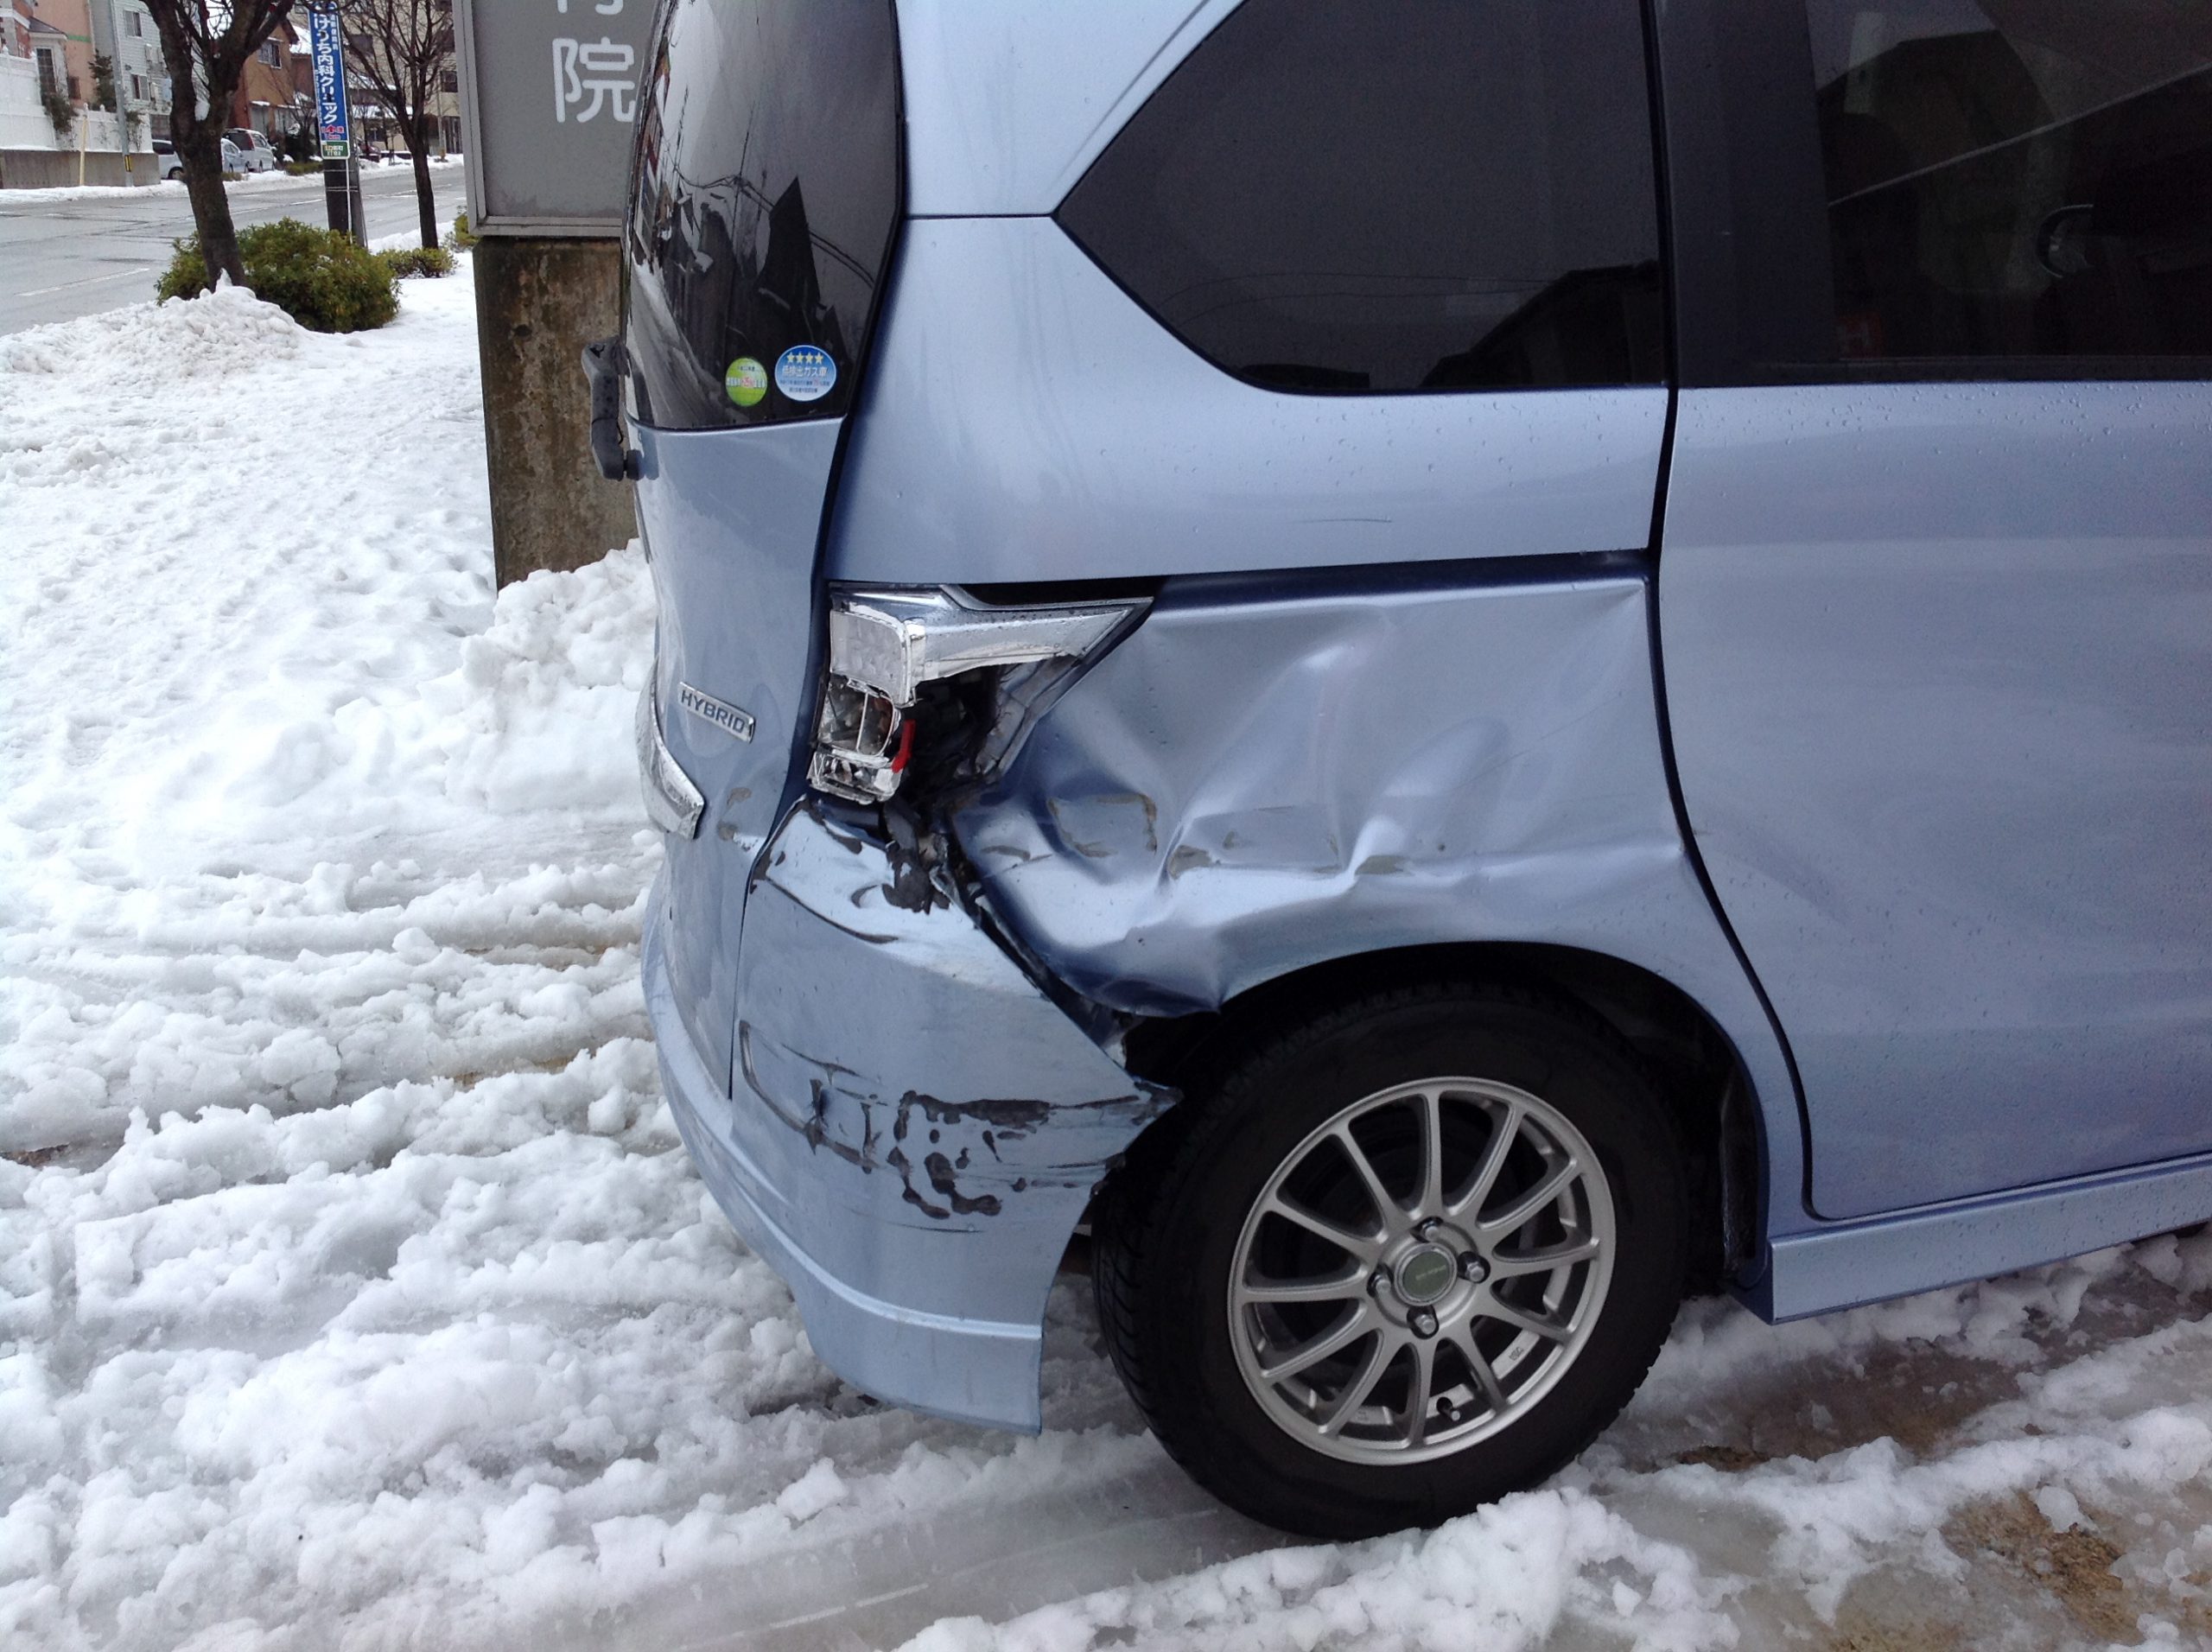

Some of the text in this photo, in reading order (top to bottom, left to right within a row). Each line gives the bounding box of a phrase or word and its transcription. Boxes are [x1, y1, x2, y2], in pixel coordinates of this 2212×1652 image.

[314, 3, 338, 124] けうち内科クリニック
[552, 0, 637, 124] 院
[680, 689, 746, 734] HYBRID
